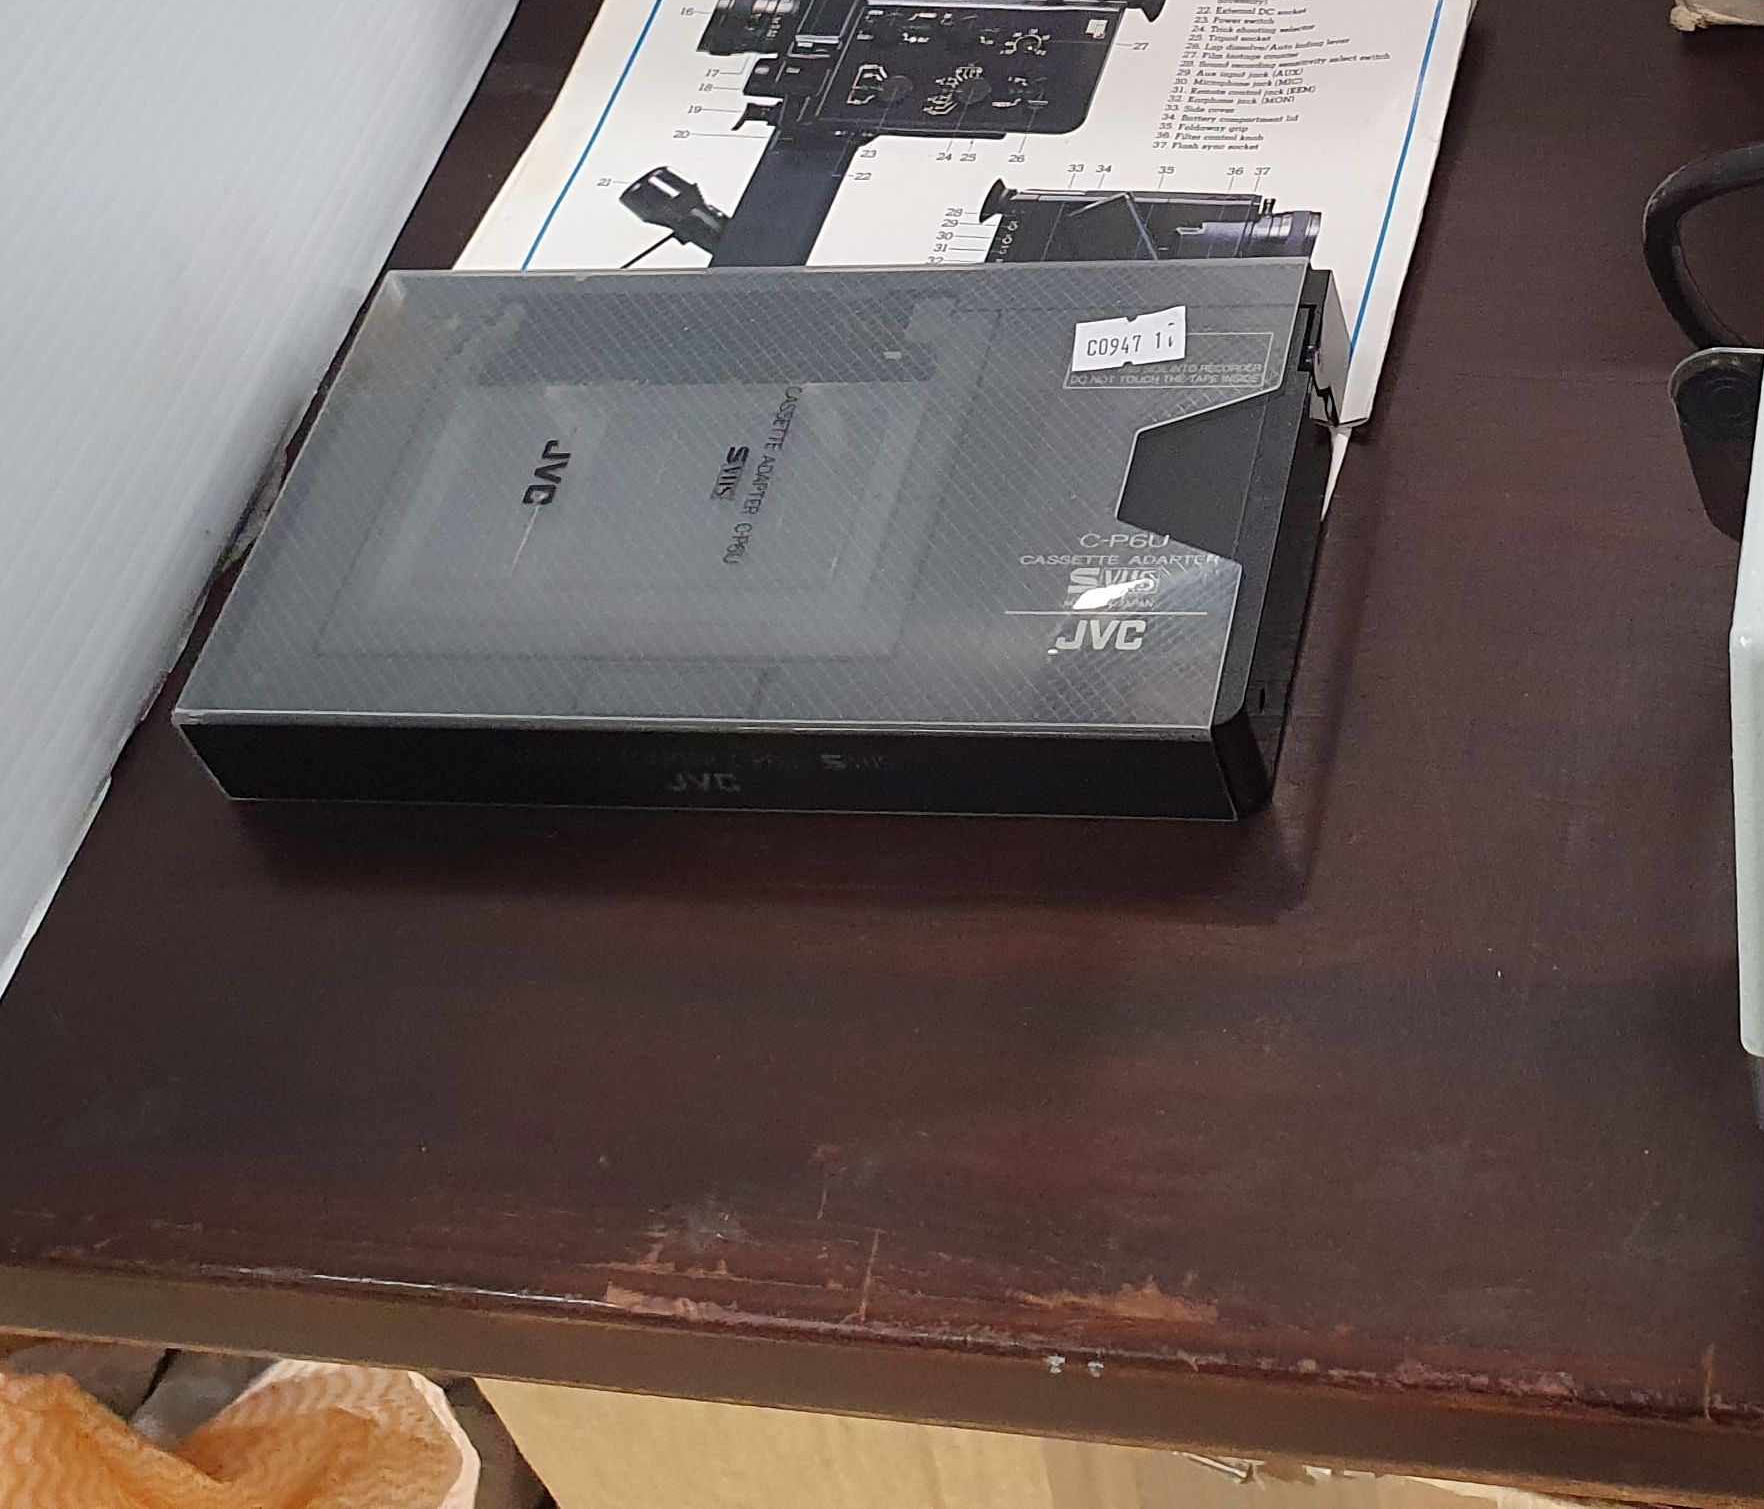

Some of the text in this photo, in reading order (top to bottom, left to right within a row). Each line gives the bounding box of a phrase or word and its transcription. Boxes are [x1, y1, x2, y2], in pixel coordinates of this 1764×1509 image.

[680, 6, 694, 16] 16
[1131, 41, 1150, 52] 27
[704, 68, 720, 78] 17
[698, 82, 713, 92] 18
[687, 104, 702, 115] 19
[673, 130, 690, 139] 20
[859, 149, 877, 159] 23
[935, 152, 954, 163] 24
[959, 152, 977, 163] 25
[1007, 153, 1026, 164] 26
[1067, 163, 1085, 174] 33
[1095, 164, 1113, 175] 34
[1157, 165, 1175, 176] 35
[1226, 166, 1244, 177] 36
[1252, 165, 1271, 176] 37
[853, 171, 873, 181] 22
[596, 177, 612, 187] 21
[945, 208, 964, 218] 28
[940, 218, 960, 228] 29
[935, 231, 955, 242] 30
[933, 243, 949, 254] 31
[1119, 375, 1161, 384] TOUCH
[521, 440, 572, 505] JVC
[1079, 533, 1170, 549] C-P6U
[1019, 555, 1120, 566] CASSETTE
[1055, 619, 1147, 651] JVC
